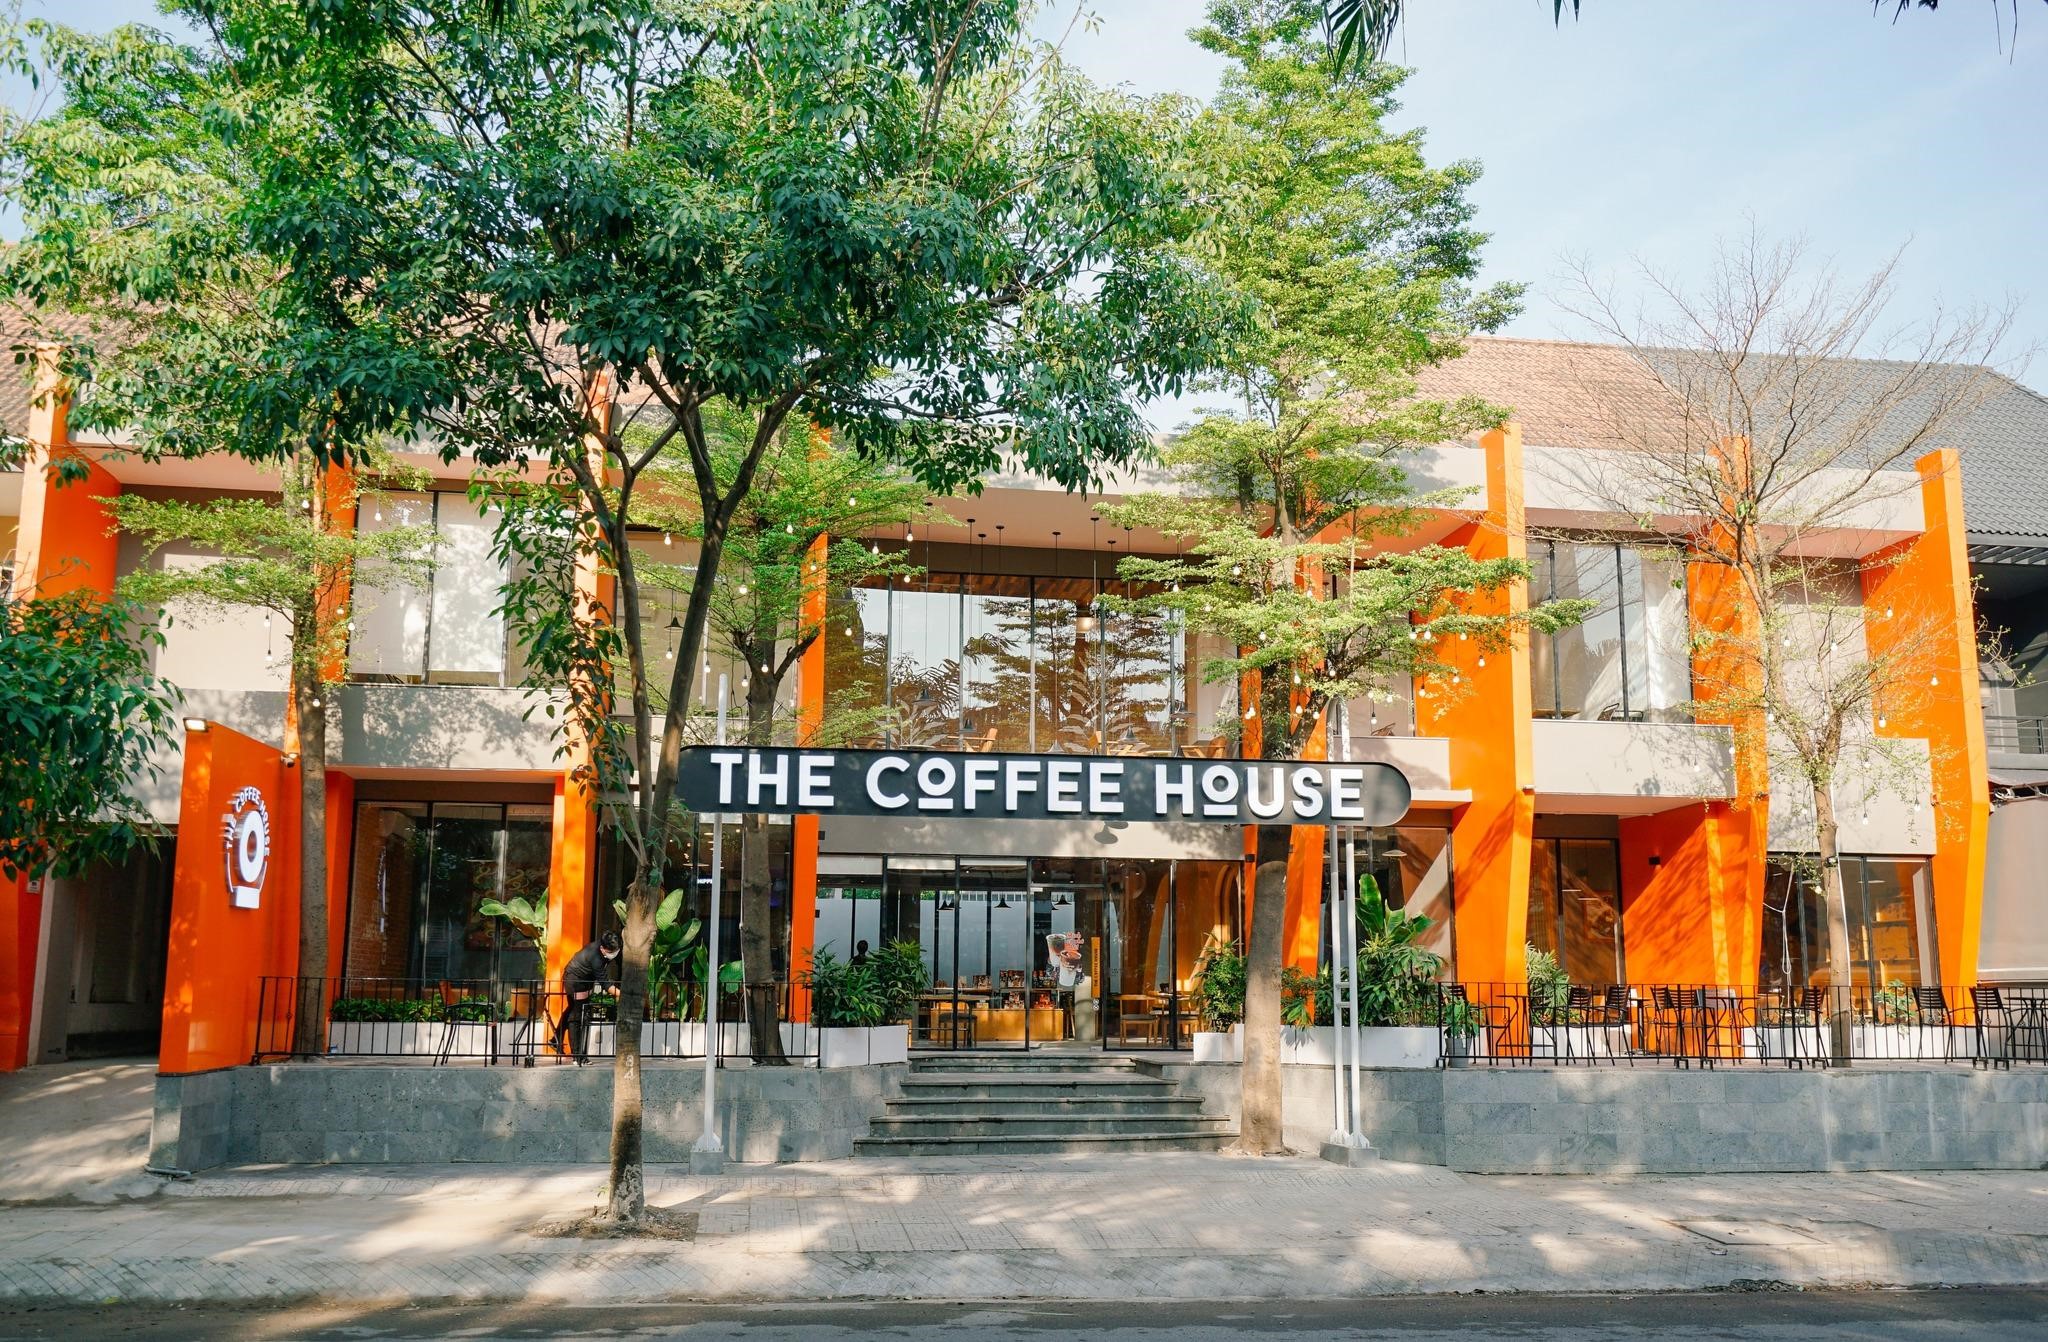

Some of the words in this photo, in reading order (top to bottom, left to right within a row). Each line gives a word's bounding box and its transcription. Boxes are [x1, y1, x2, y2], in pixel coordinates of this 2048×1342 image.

[710, 753, 835, 807] THE
[865, 755, 1124, 813] COFFEE
[1154, 763, 1365, 819] HOUSE
[235, 786, 262, 813] COFFEE
[259, 799, 271, 857] HOUSE
